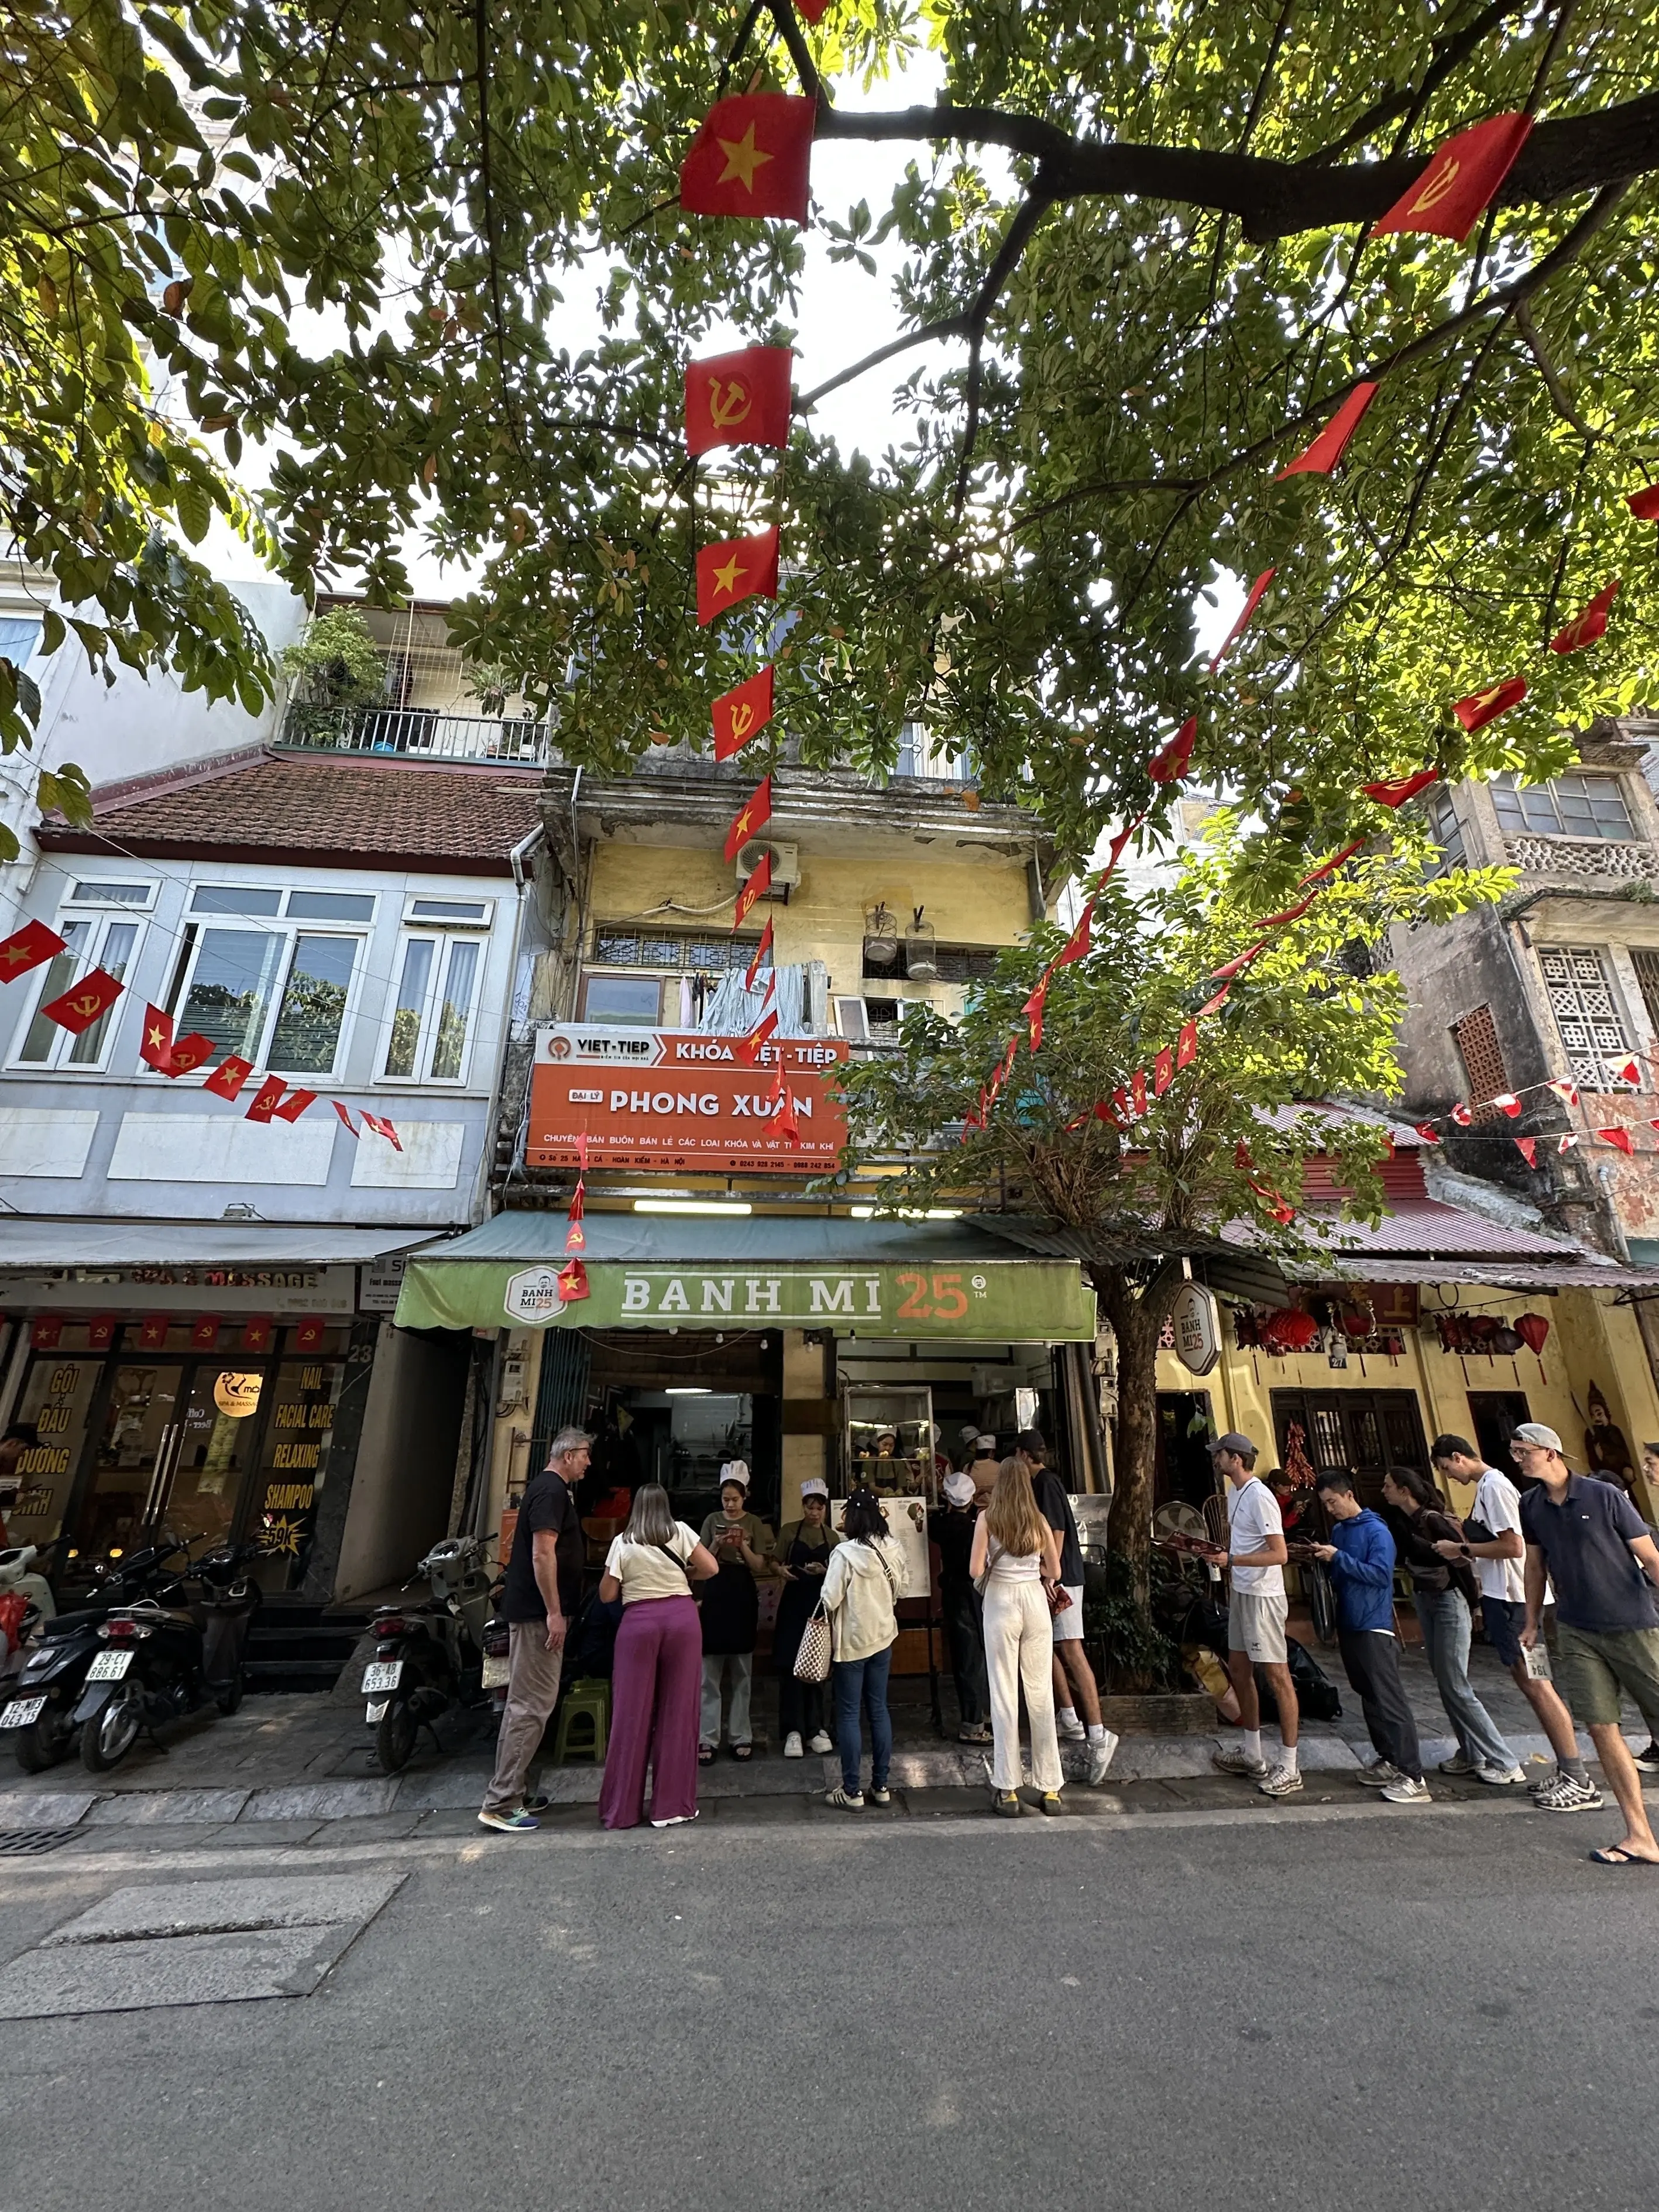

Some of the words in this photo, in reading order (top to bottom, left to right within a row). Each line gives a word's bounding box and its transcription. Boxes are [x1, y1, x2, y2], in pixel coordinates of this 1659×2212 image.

[676, 1039, 734, 1060] KHÓA
[572, 1091, 586, 1101] ĐẠI
[590, 1091, 600, 1100] LÝ
[610, 1090, 719, 1115] PHONG
[544, 1134, 579, 1143] CHUYÊN
[587, 1134, 604, 1144] BÁN
[609, 1134, 634, 1145] BUÔN
[640, 1136, 658, 1145] BÁN
[678, 1136, 696, 1146] CÁC
[724, 1139, 748, 1148] KHÓA
[752, 1140, 762, 1149] VÀ
[766, 1139, 780, 1150] VẬT
[800, 1142, 815, 1150] KIM
[820, 1141, 834, 1150] KHÍ
[612, 1155, 630, 1164] HOÀN
[661, 1156, 669, 1165] HÀ
[621, 1279, 781, 1311] BANH
[810, 1280, 881, 1311] MI
[895, 1273, 968, 1319] 25
[1181, 1319, 1201, 1334] BANH
[348, 1345, 373, 1363] 23
[1331, 1359, 1344, 1367] 27
[300, 1366, 322, 1390] NAIL
[274, 1404, 307, 1428] FACIAL
[308, 1404, 336, 1428] CARE
[272, 1443, 321, 1469] RELAXING
[265, 1483, 314, 1510] SHAMPOO
[90, 1667, 123, 1678] 886.61
[364, 1676, 397, 1690] 653.36
